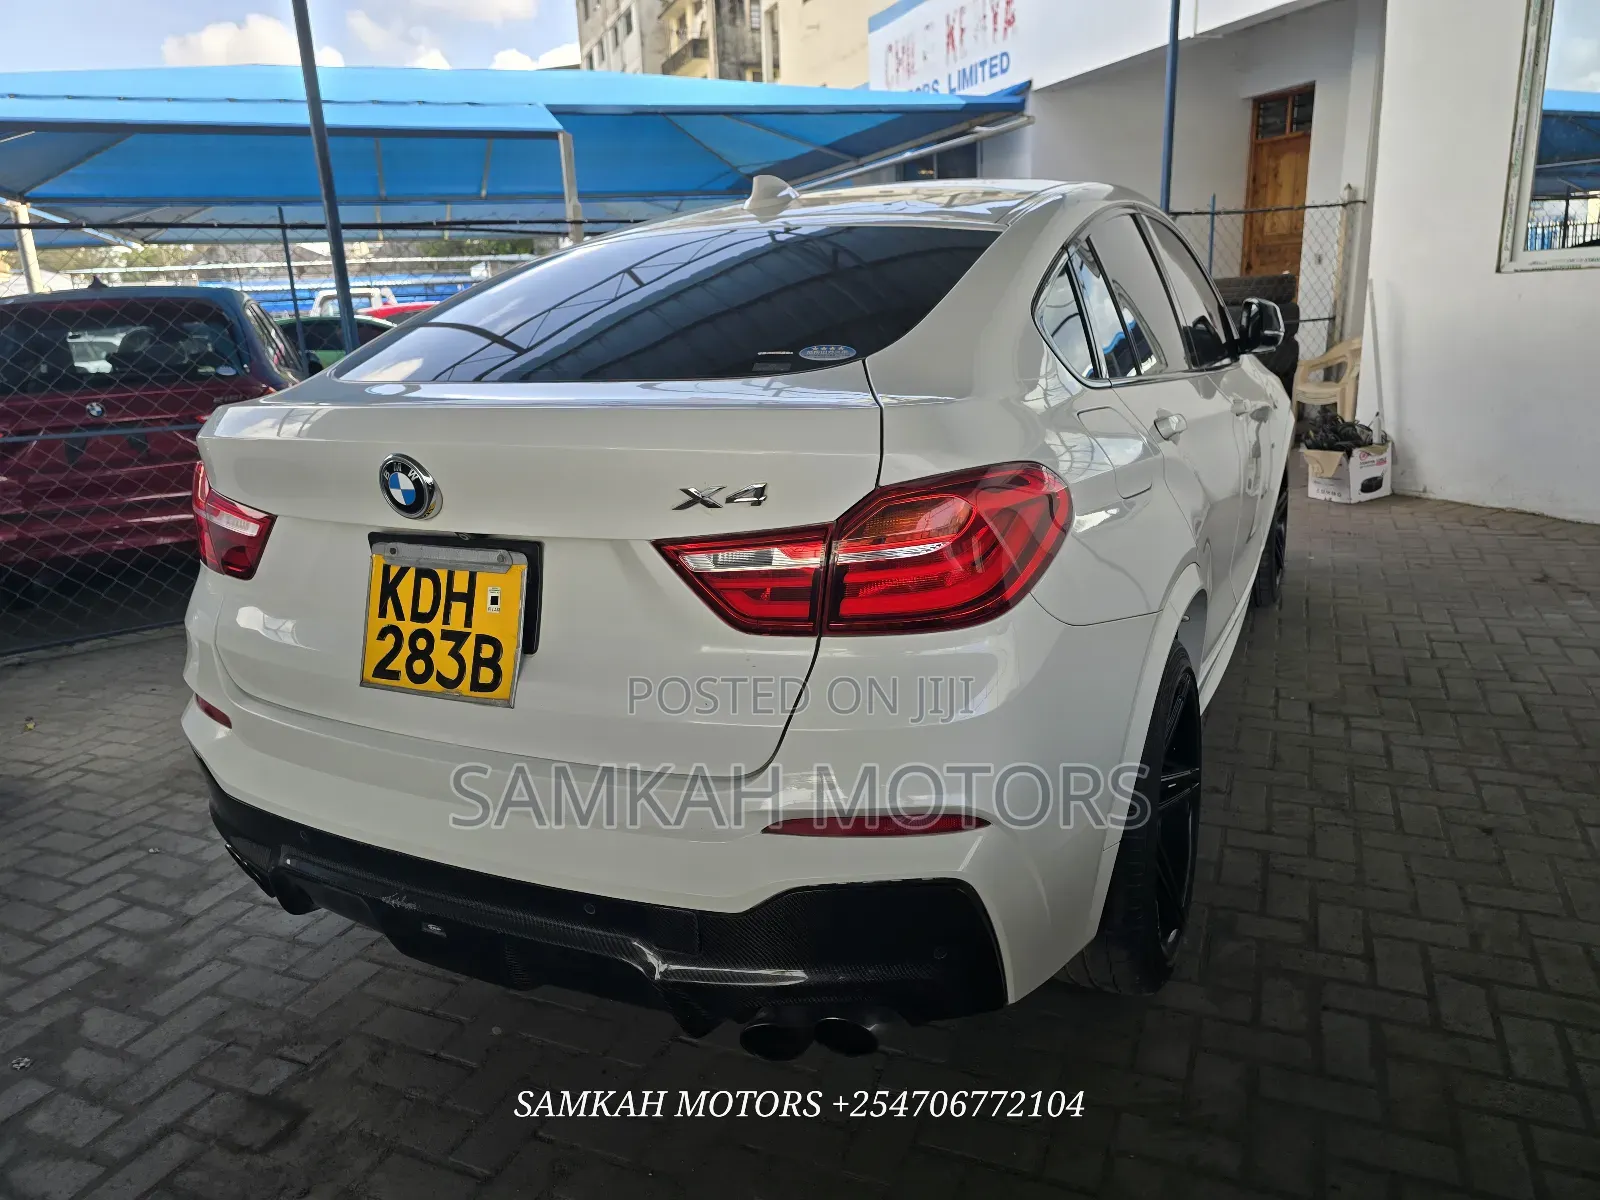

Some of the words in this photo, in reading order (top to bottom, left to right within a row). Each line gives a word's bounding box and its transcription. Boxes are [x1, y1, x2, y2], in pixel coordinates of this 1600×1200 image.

[948, 51, 1010, 94] LIMITED
[671, 482, 767, 511] X4
[377, 563, 478, 629] KDH
[371, 624, 504, 693] 283B
